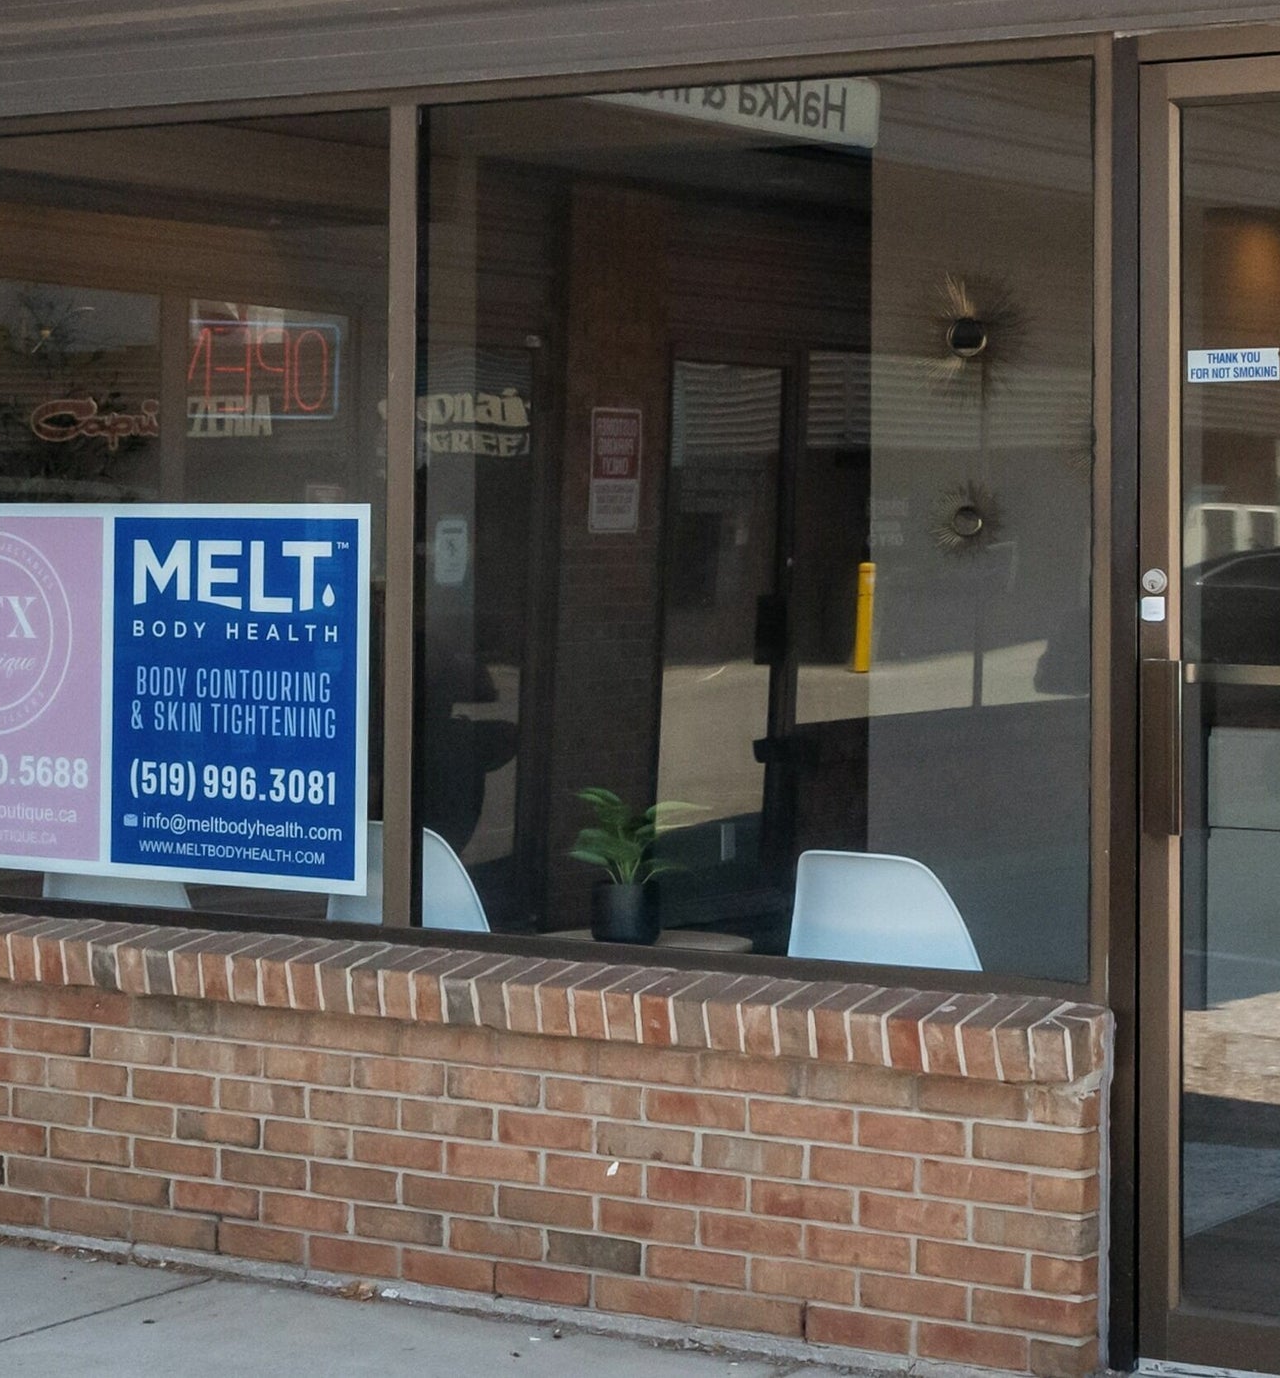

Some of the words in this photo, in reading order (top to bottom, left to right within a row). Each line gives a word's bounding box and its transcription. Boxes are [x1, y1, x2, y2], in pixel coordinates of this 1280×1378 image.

[1190, 368, 1209, 379] FOR
[1212, 367, 1231, 379] NOT
[1233, 366, 1278, 378] SMOKING
[1207, 353, 1238, 364] THANK
[1241, 351, 1261, 364] YOU
[133, 620, 206, 638] BODY
[226, 623, 338, 643] HEALTH
[136, 665, 187, 697] BODY
[196, 668, 331, 703] CONTOURING
[131, 699, 144, 730] &
[154, 700, 202, 733] SKIN
[210, 702, 337, 740] TIGHTENING
[130, 757, 197, 802] (519)
[203, 764, 336, 806] 996.3081
[142, 812, 342, 848] info@meltbodyhealth.com
[138, 839, 326, 866] WWW.MELTBODYHEALTH.COM
